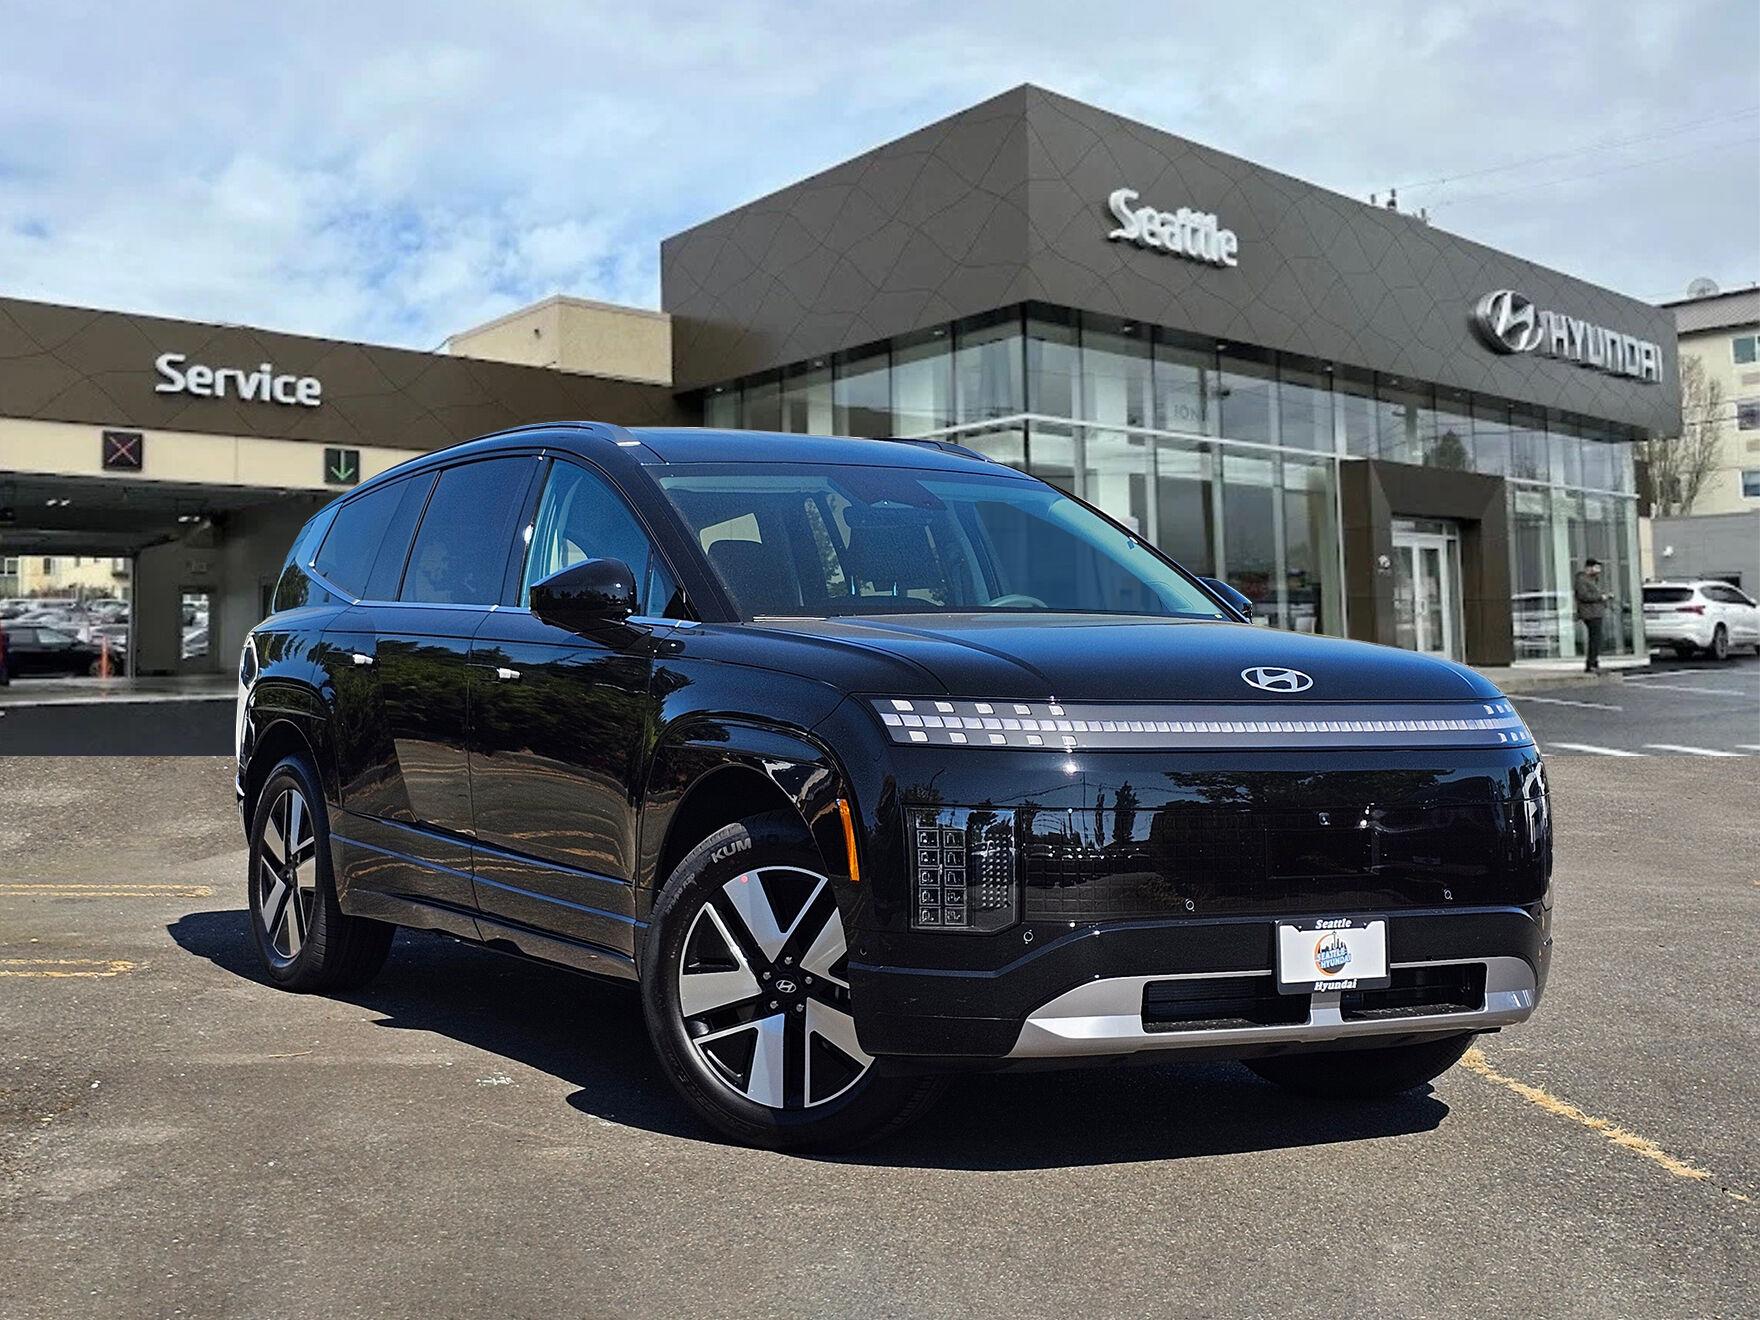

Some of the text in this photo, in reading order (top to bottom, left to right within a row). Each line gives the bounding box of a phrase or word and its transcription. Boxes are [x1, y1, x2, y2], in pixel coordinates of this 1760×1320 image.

[1109, 188, 1238, 267] Seattle
[1541, 311, 1663, 385] HYUNDAI
[155, 352, 322, 407] Service
[1315, 918, 1352, 929] Seattle
[1314, 979, 1358, 992] Hyundai
